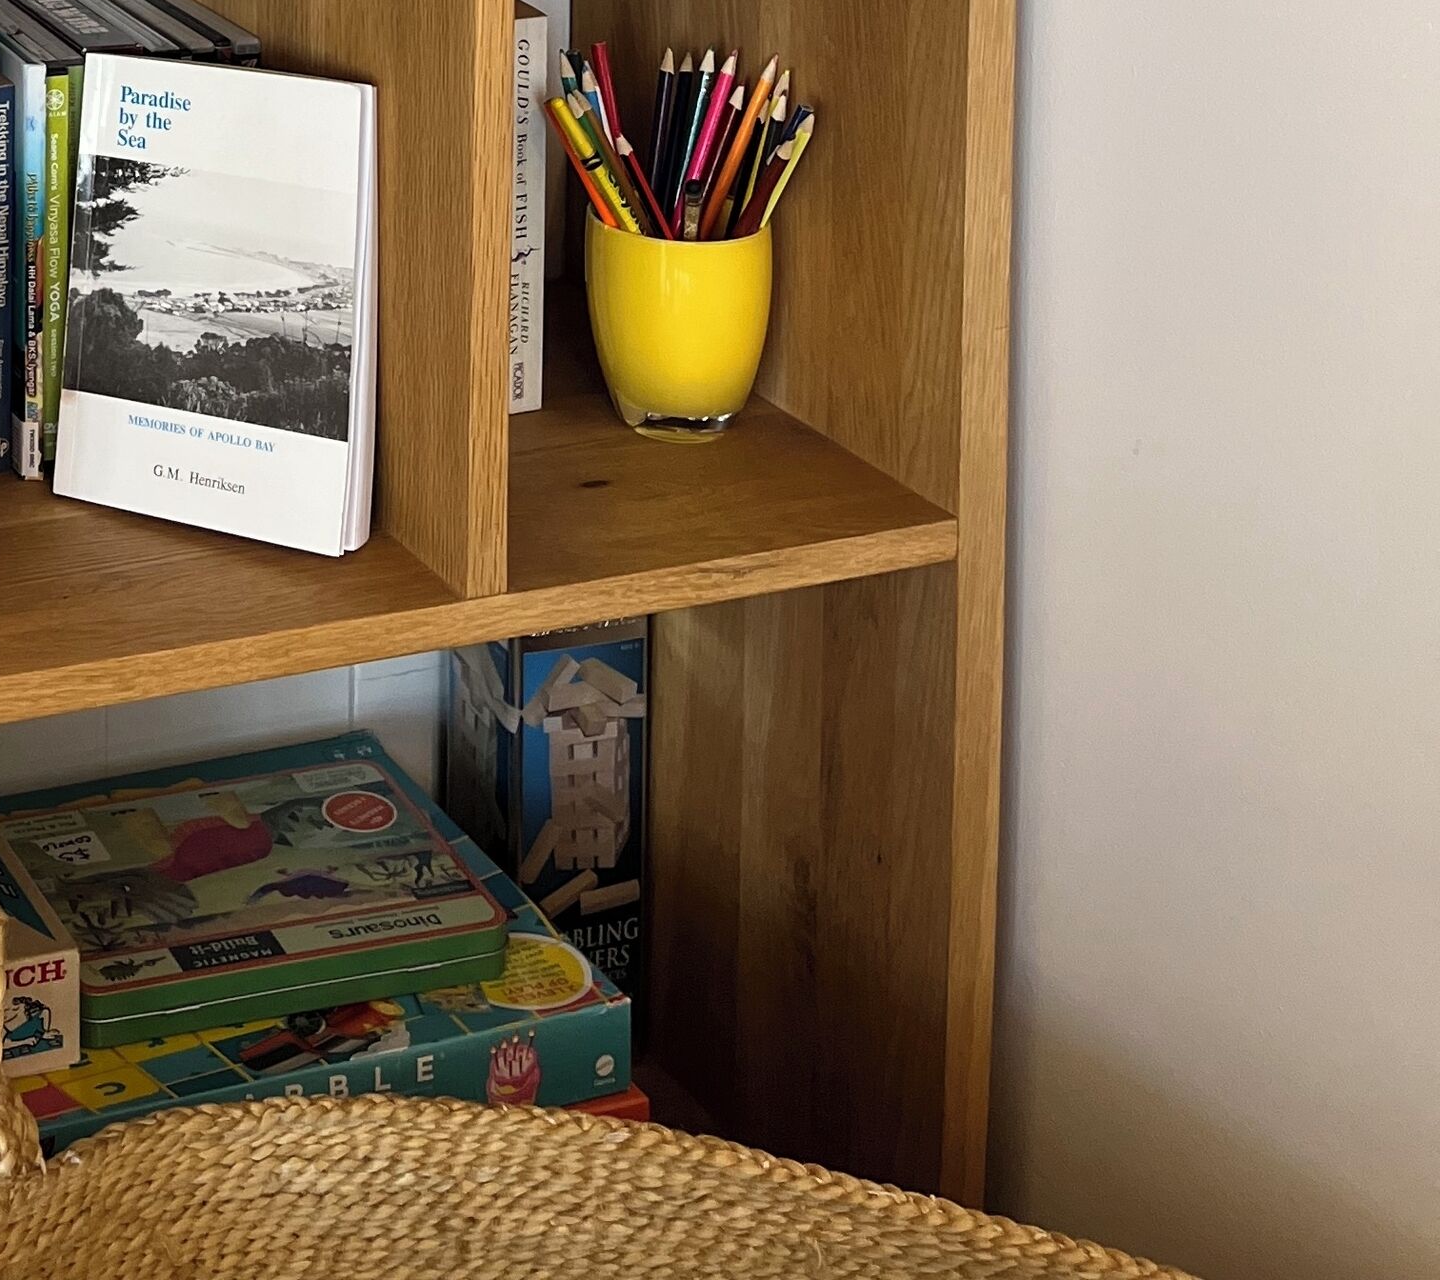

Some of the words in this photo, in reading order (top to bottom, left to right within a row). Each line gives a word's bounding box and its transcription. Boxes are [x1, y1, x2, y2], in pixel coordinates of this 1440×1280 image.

[516, 38, 531, 125] GOULD'S
[119, 84, 192, 112] Paradise
[119, 106, 138, 130] by
[145, 111, 172, 131] the
[117, 128, 146, 149] Sea
[516, 133, 528, 168] Book
[516, 172, 528, 186] of
[47, 193, 61, 246] Vinyasa
[514, 193, 528, 241] FISH
[28, 265, 37, 279] HH
[48, 247, 61, 279] Flow
[27, 281, 37, 303] Dalai
[49, 281, 61, 323] YOGA
[27, 304, 37, 329] Lama
[509, 273, 520, 356] FLANAGAN
[520, 281, 531, 345] RICHARD
[24, 363, 38, 397] Iyengar
[512, 361, 525, 402] PICADOR
[128, 414, 186, 435] MEMORIES
[189, 426, 204, 438] OF
[207, 431, 252, 448] APOLLO
[255, 439, 276, 453] BAY
[189, 471, 246, 495] Henriksen
[327, 911, 443, 941] Dinosaurs
[192, 948, 273, 969] MAGNETIC
